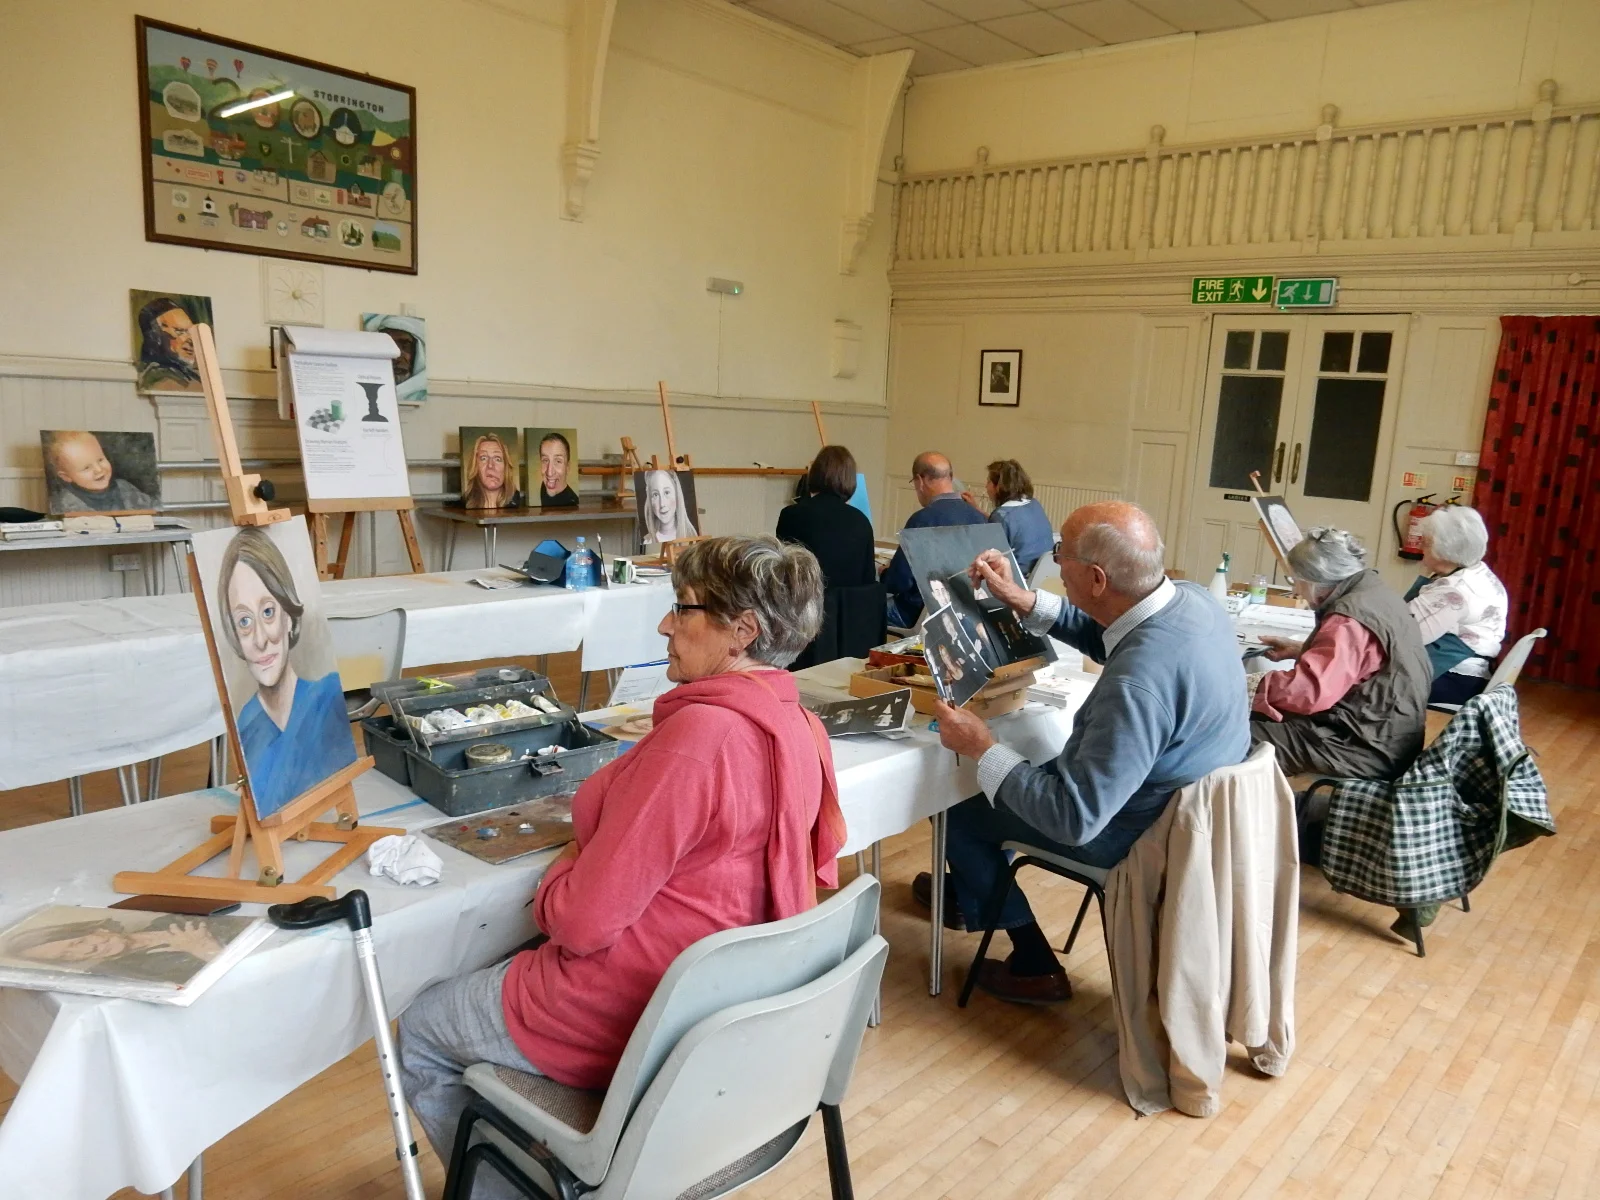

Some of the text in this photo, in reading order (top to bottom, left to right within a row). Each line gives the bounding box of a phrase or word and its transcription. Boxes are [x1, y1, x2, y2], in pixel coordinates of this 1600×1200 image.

[313, 90, 384, 113] STORRINGTON
[1198, 280, 1224, 290] FIRE
[1197, 291, 1224, 301] EXIT
